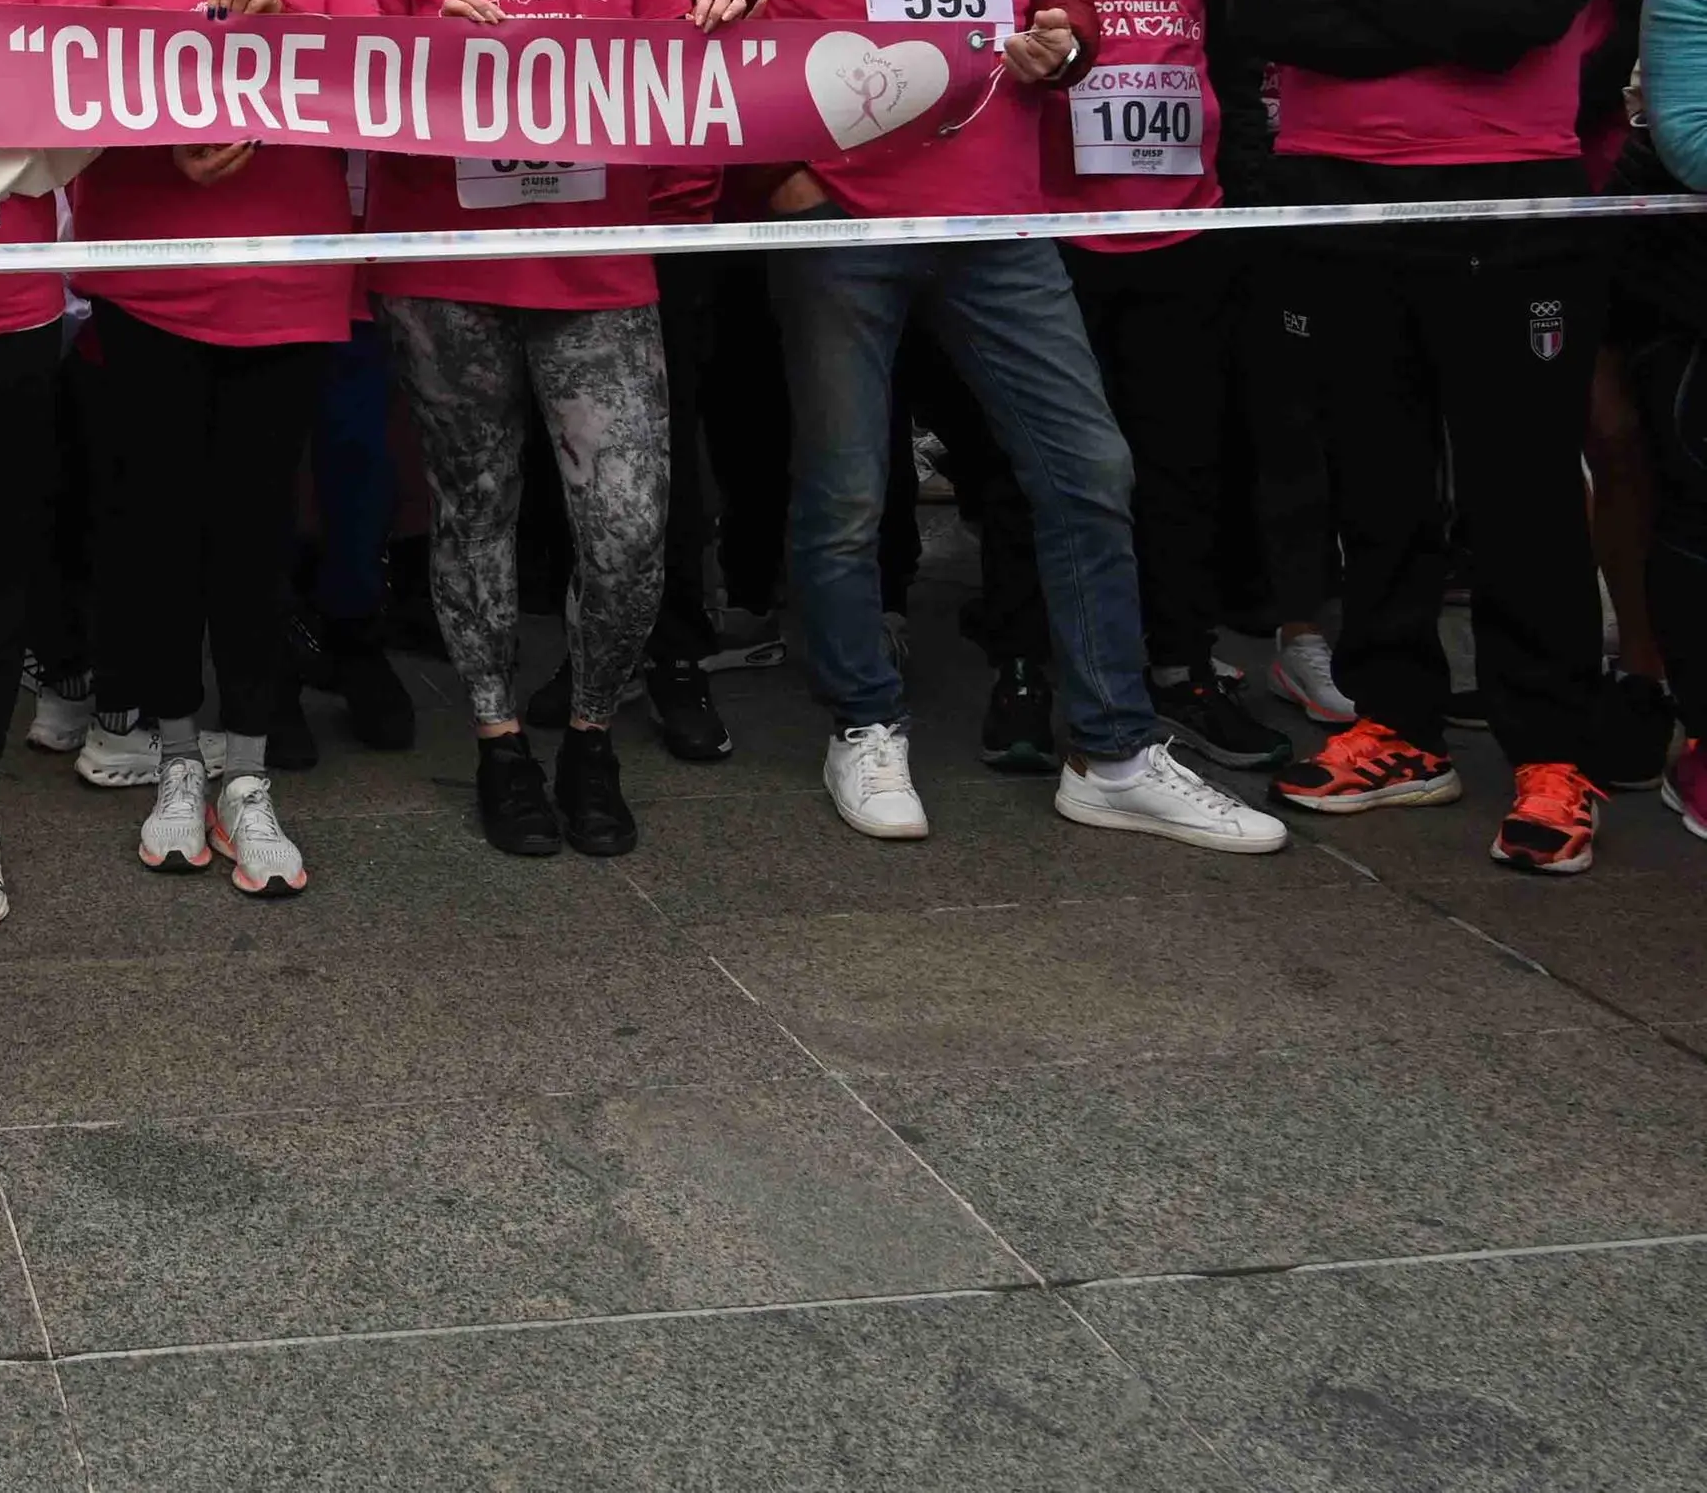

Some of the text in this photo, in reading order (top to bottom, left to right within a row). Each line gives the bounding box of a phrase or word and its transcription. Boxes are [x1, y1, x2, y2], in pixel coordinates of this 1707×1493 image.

[863, 52, 892, 68] Cuore
[9, 24, 330, 134] “CUORE
[354, 36, 431, 140] DI
[461, 37, 777, 146] DONNA”
[1088, 72, 1157, 91] CORSA
[1093, 100, 1191, 143] 1040
[1142, 149, 1164, 158] UISP
[531, 177, 560, 186] UISP
[1283, 310, 1307, 331] EA7
[1533, 321, 1559, 329] ITALIA
